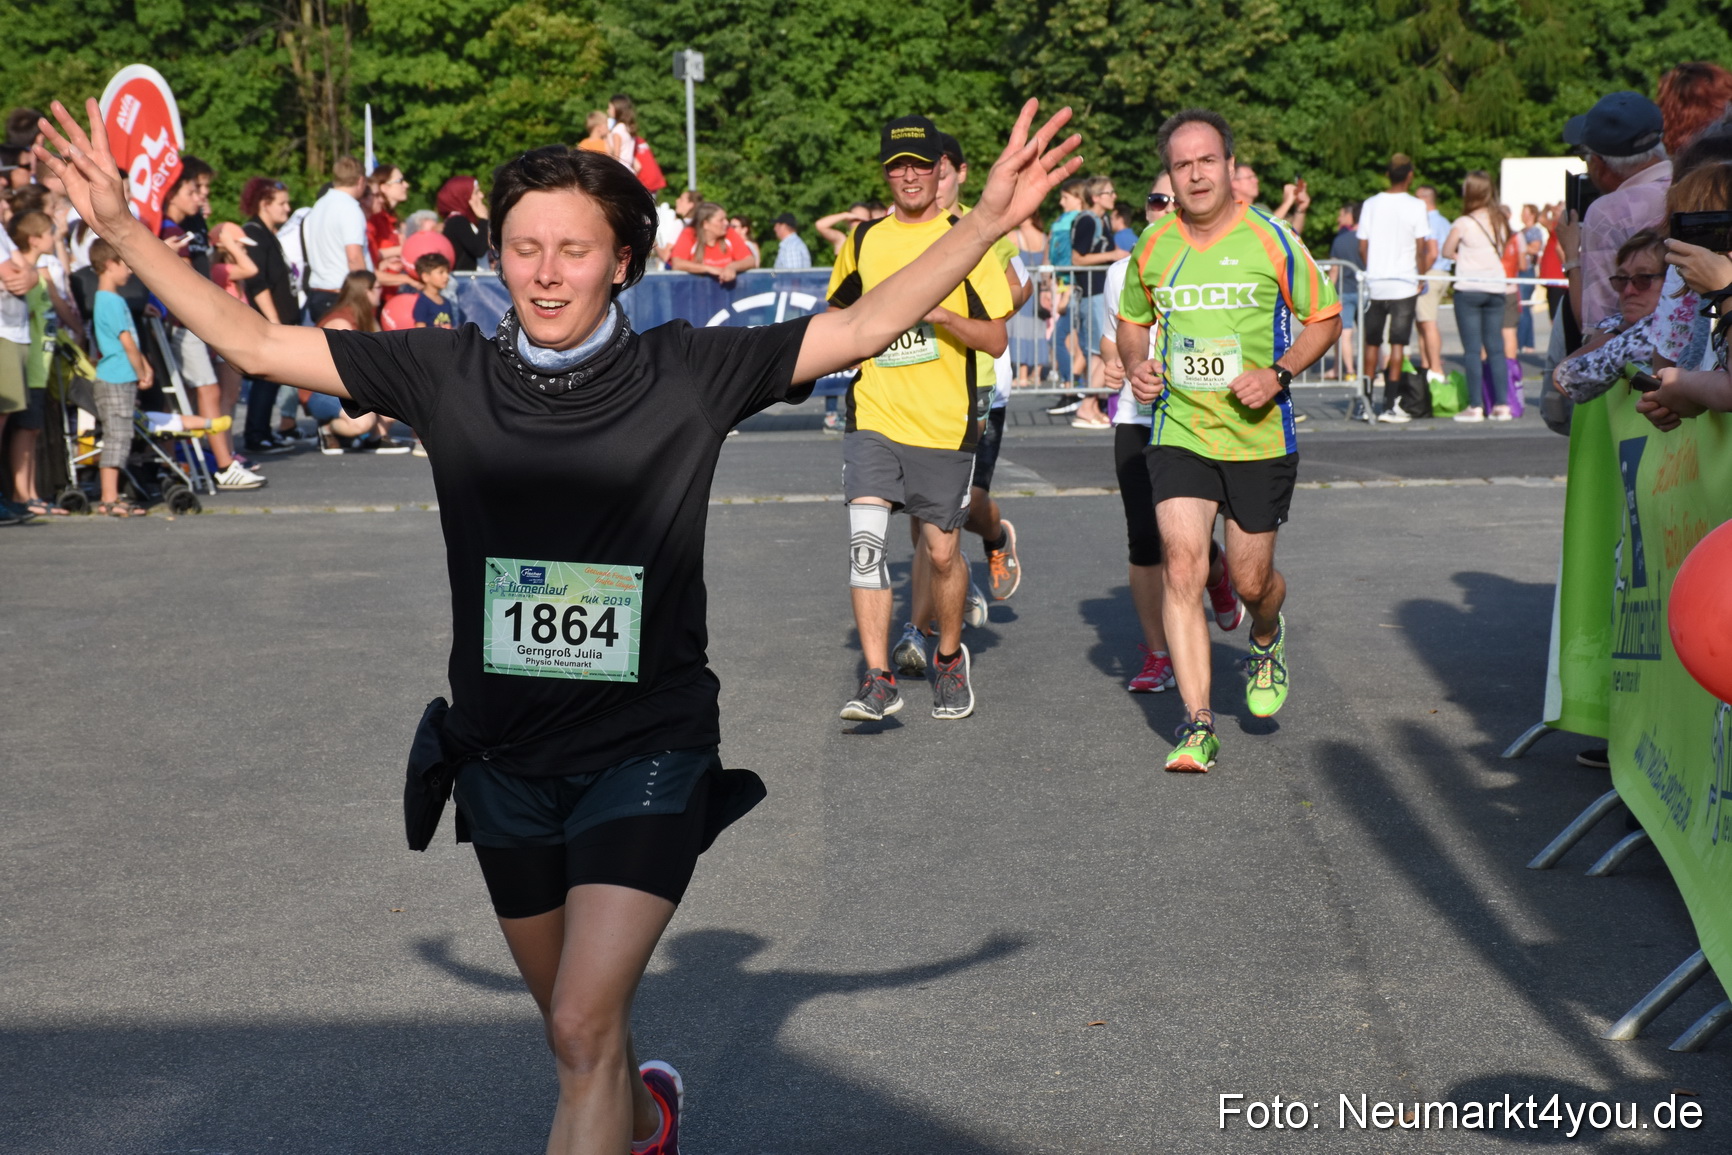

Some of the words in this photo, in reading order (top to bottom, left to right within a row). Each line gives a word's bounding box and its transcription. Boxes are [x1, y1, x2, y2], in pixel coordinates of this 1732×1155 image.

[1155, 283, 1259, 312] BOCK
[1184, 356, 1224, 376] 330
[508, 581, 568, 596] firmenlauf
[580, 595, 599, 605] run
[603, 596, 631, 606] 2019
[504, 602, 619, 647] 1864
[517, 644, 571, 659] Gerngroß
[575, 648, 603, 659] Julia
[525, 658, 552, 667] Physio
[554, 659, 592, 668] Neumarkt
